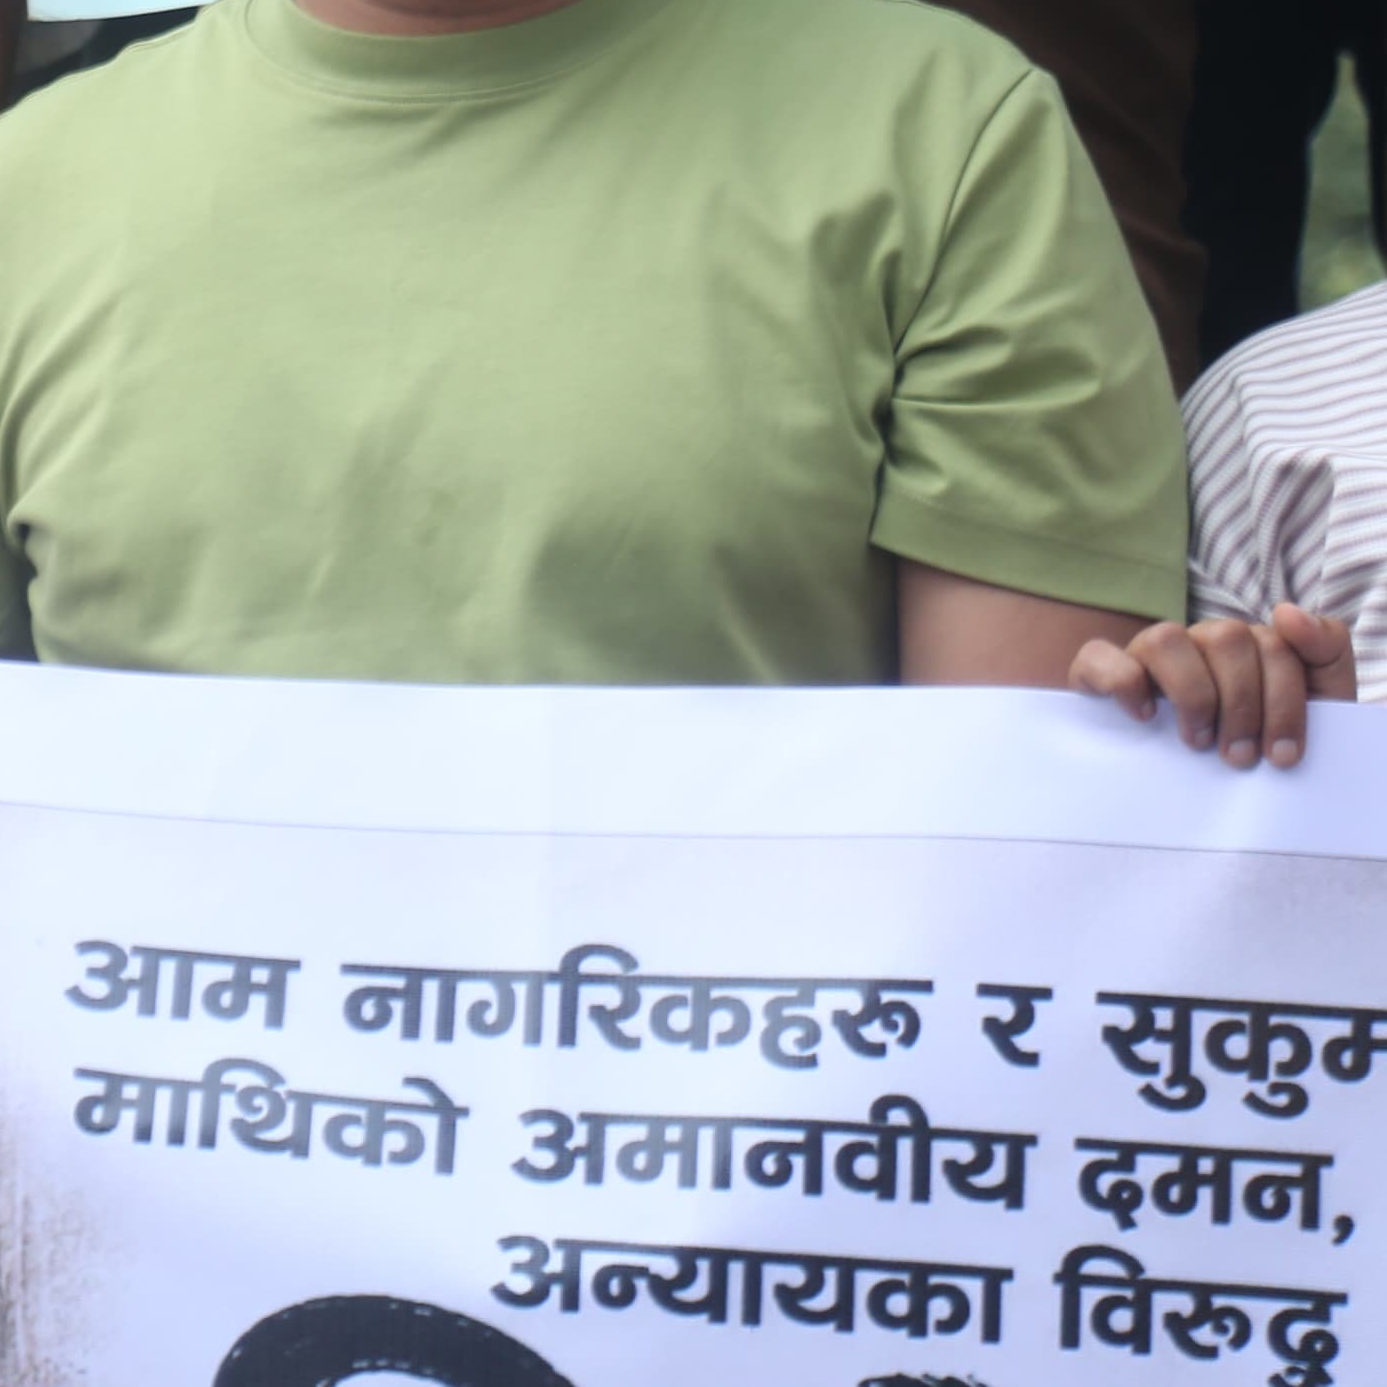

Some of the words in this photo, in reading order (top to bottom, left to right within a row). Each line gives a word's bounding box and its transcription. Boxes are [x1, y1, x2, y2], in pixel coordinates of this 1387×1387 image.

[63, 938, 302, 1031] आम
[976, 982, 1054, 1068] र
[73, 1056, 470, 1177] माथिको
[510, 1094, 1038, 1211] अमानवीय
[490, 1234, 1014, 1345] अन्यायका
